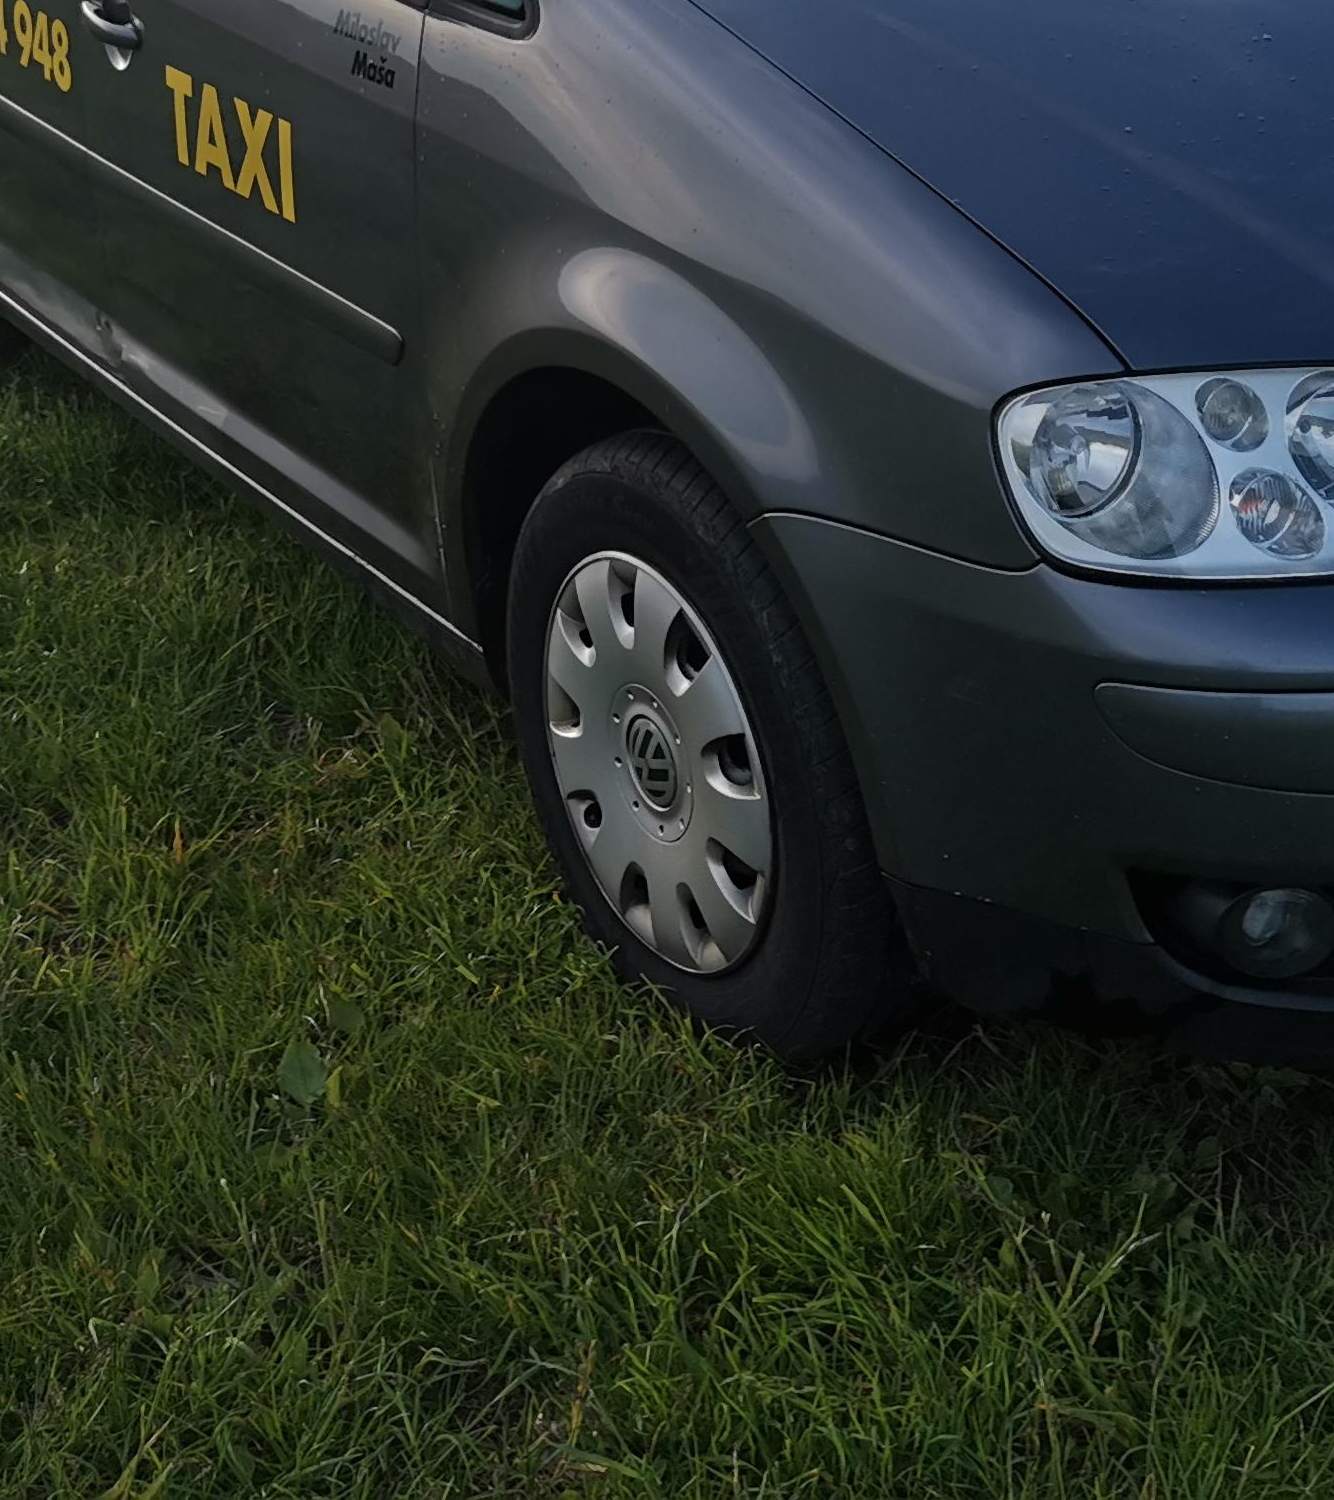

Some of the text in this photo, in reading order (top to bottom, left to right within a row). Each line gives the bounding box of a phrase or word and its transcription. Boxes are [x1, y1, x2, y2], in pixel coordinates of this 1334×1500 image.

[333, 9, 402, 53] Miloslav
[351, 50, 396, 89] Maša
[165, 64, 296, 223] TAXI
